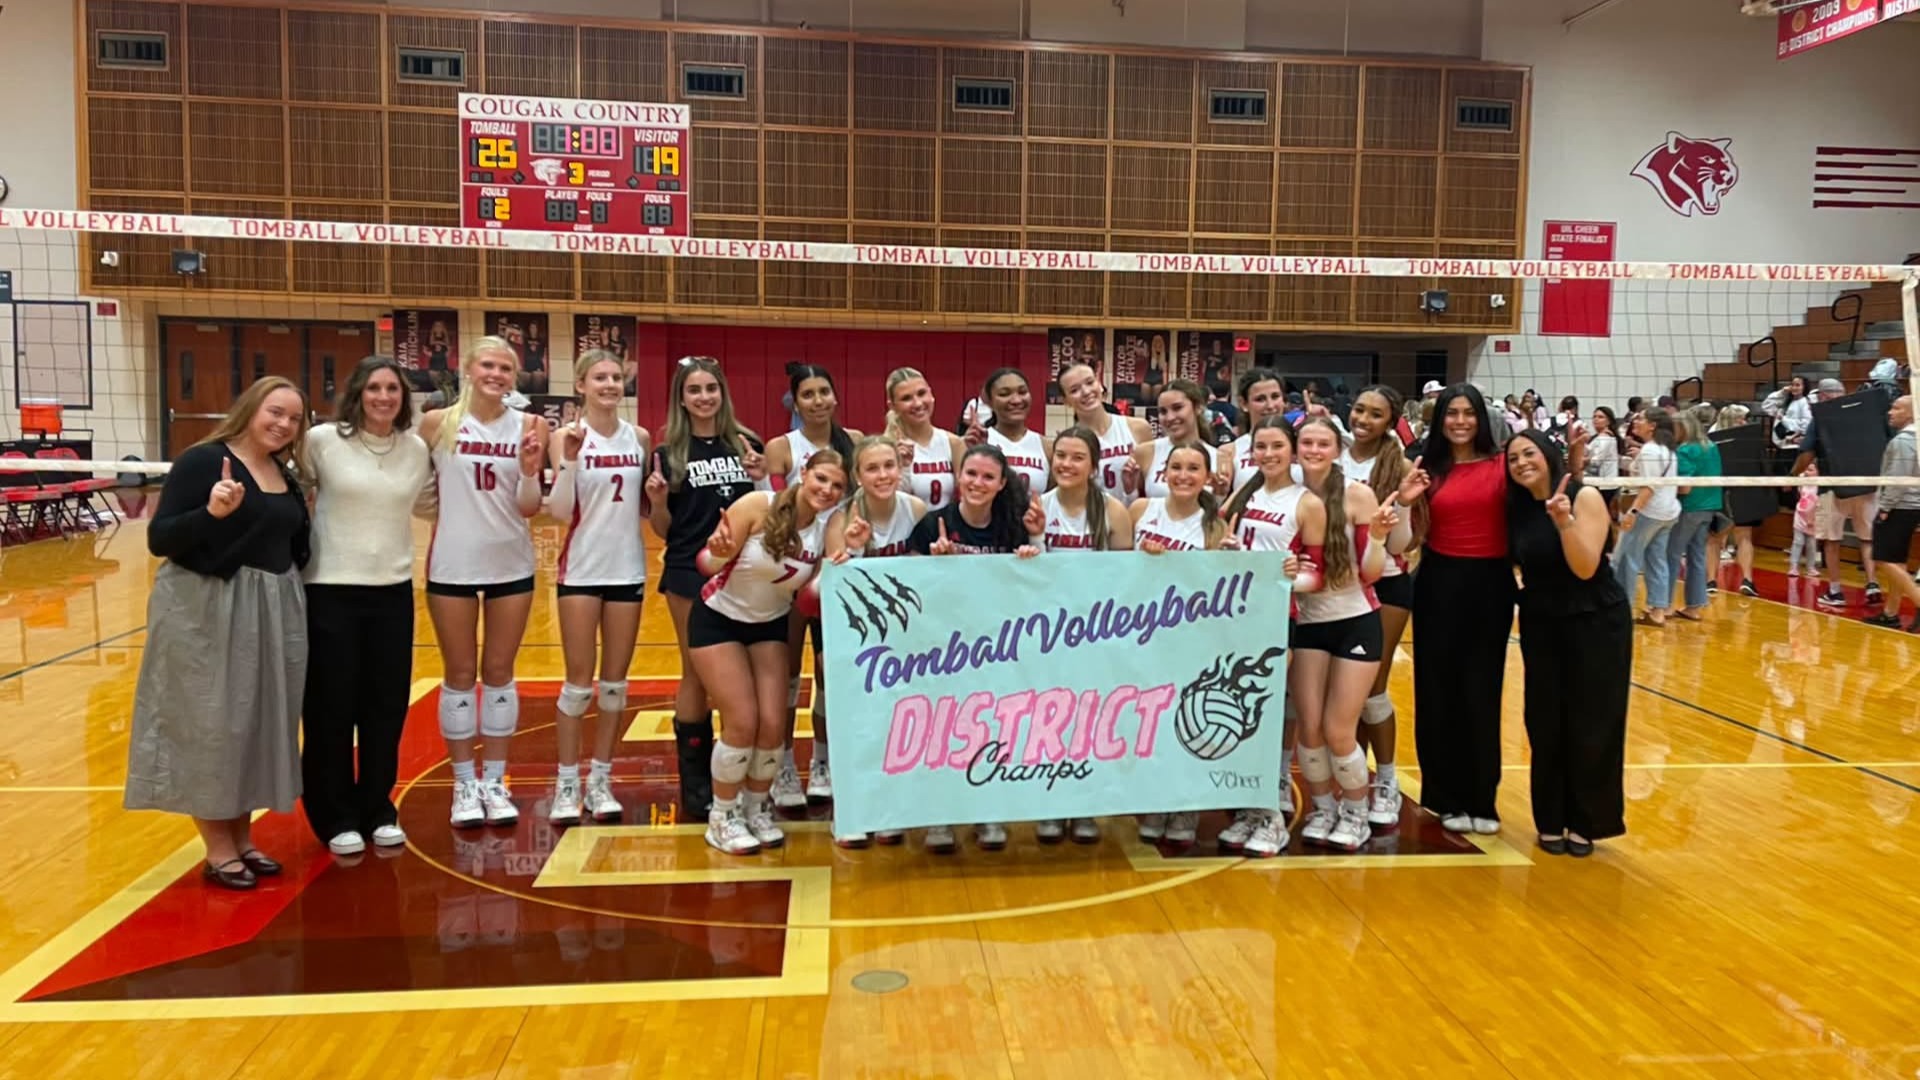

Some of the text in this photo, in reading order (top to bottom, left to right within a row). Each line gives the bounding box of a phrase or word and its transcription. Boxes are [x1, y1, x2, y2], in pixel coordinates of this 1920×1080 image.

[1812, 0, 1840, 23] 2009
[465, 97, 684, 124] COUGAR COUNTRY
[470, 121, 518, 136] TOMBALL
[634, 129, 679, 143] VISITOR
[478, 138, 518, 169] 25
[653, 146, 679, 176] 19
[568, 162, 585, 185] 3
[480, 187, 509, 197] FOULS
[545, 189, 613, 202] PLAYER FOULS
[644, 194, 671, 204] FOULS
[494, 197, 510, 220] 2
[23, 210, 183, 233] VOLLEYBALL
[228, 219, 508, 247] TOMBALL VOLLEYBALL
[552, 233, 814, 260] TOMBALL VOLLEYBALL
[853, 245, 1098, 269] TOMBALL VOLLEYBALL
[1136, 254, 1370, 274] TOMBALL VOLLEYBALL
[1408, 259, 1633, 278] TOMBALL VOLLEYBALL
[1668, 263, 1889, 281] TOMBALL VOLLEYBALL
[398, 341, 408, 368] KAIA
[1116, 345, 1126, 383] TAYLOR
[584, 454, 641, 469] TOMBALL
[687, 456, 745, 477] TOMBAL
[472, 461, 496, 491] 16
[1103, 464, 1117, 489] 6
[610, 474, 624, 502] 2
[770, 563, 799, 584] 7
[854, 571, 1254, 693] Tomball Volleyball!
[882, 683, 1176, 775] DISTRICT
[965, 740, 1094, 791] Champs
[1225, 770, 1262, 789] Cheer
